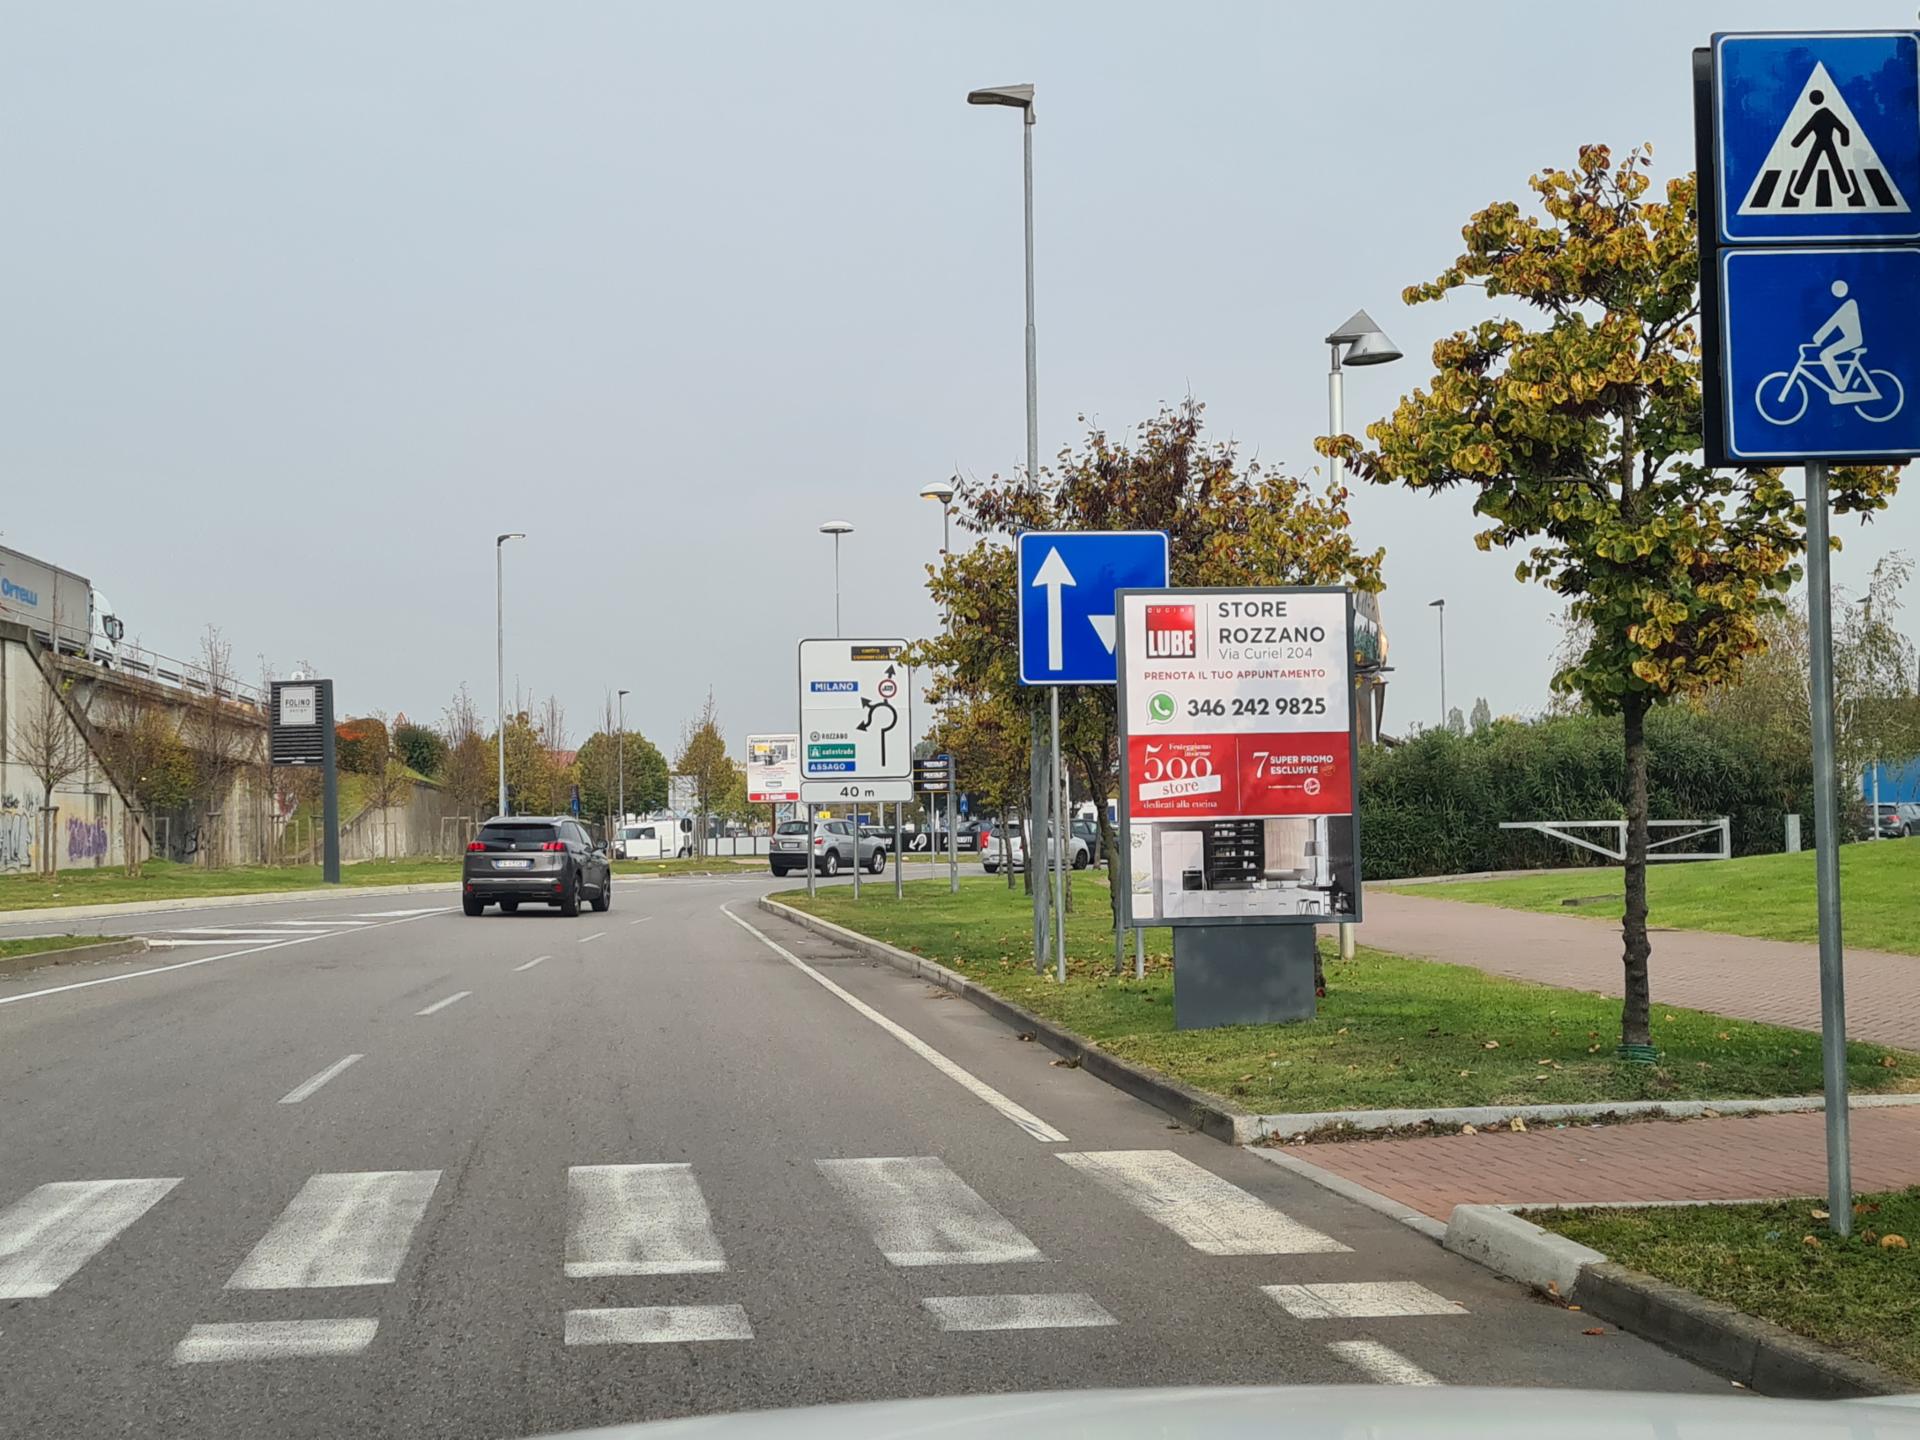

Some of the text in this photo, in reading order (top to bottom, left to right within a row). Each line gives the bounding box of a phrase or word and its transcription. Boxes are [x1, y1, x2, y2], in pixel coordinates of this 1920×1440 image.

[1218, 601, 1287, 618] STORE
[1219, 626, 1325, 644] ROZZANO
[1148, 630, 1194, 656] LUBE
[1218, 647, 1313, 660] Via Curiel 204
[1144, 668, 1326, 681] PRENOTA IL TUO APPUNTAMENTO
[815, 682, 854, 691] MILANO
[1187, 697, 1327, 717] 346 242 9825
[1143, 743, 1213, 782] 500
[1252, 751, 1269, 779] 7
[1270, 754, 1334, 765] SUPER PROMO
[810, 763, 846, 771] ASSAGO
[1270, 765, 1319, 775] ESCLUSIVE
[840, 786, 875, 798] 40 m
[1162, 780, 1200, 796] store
